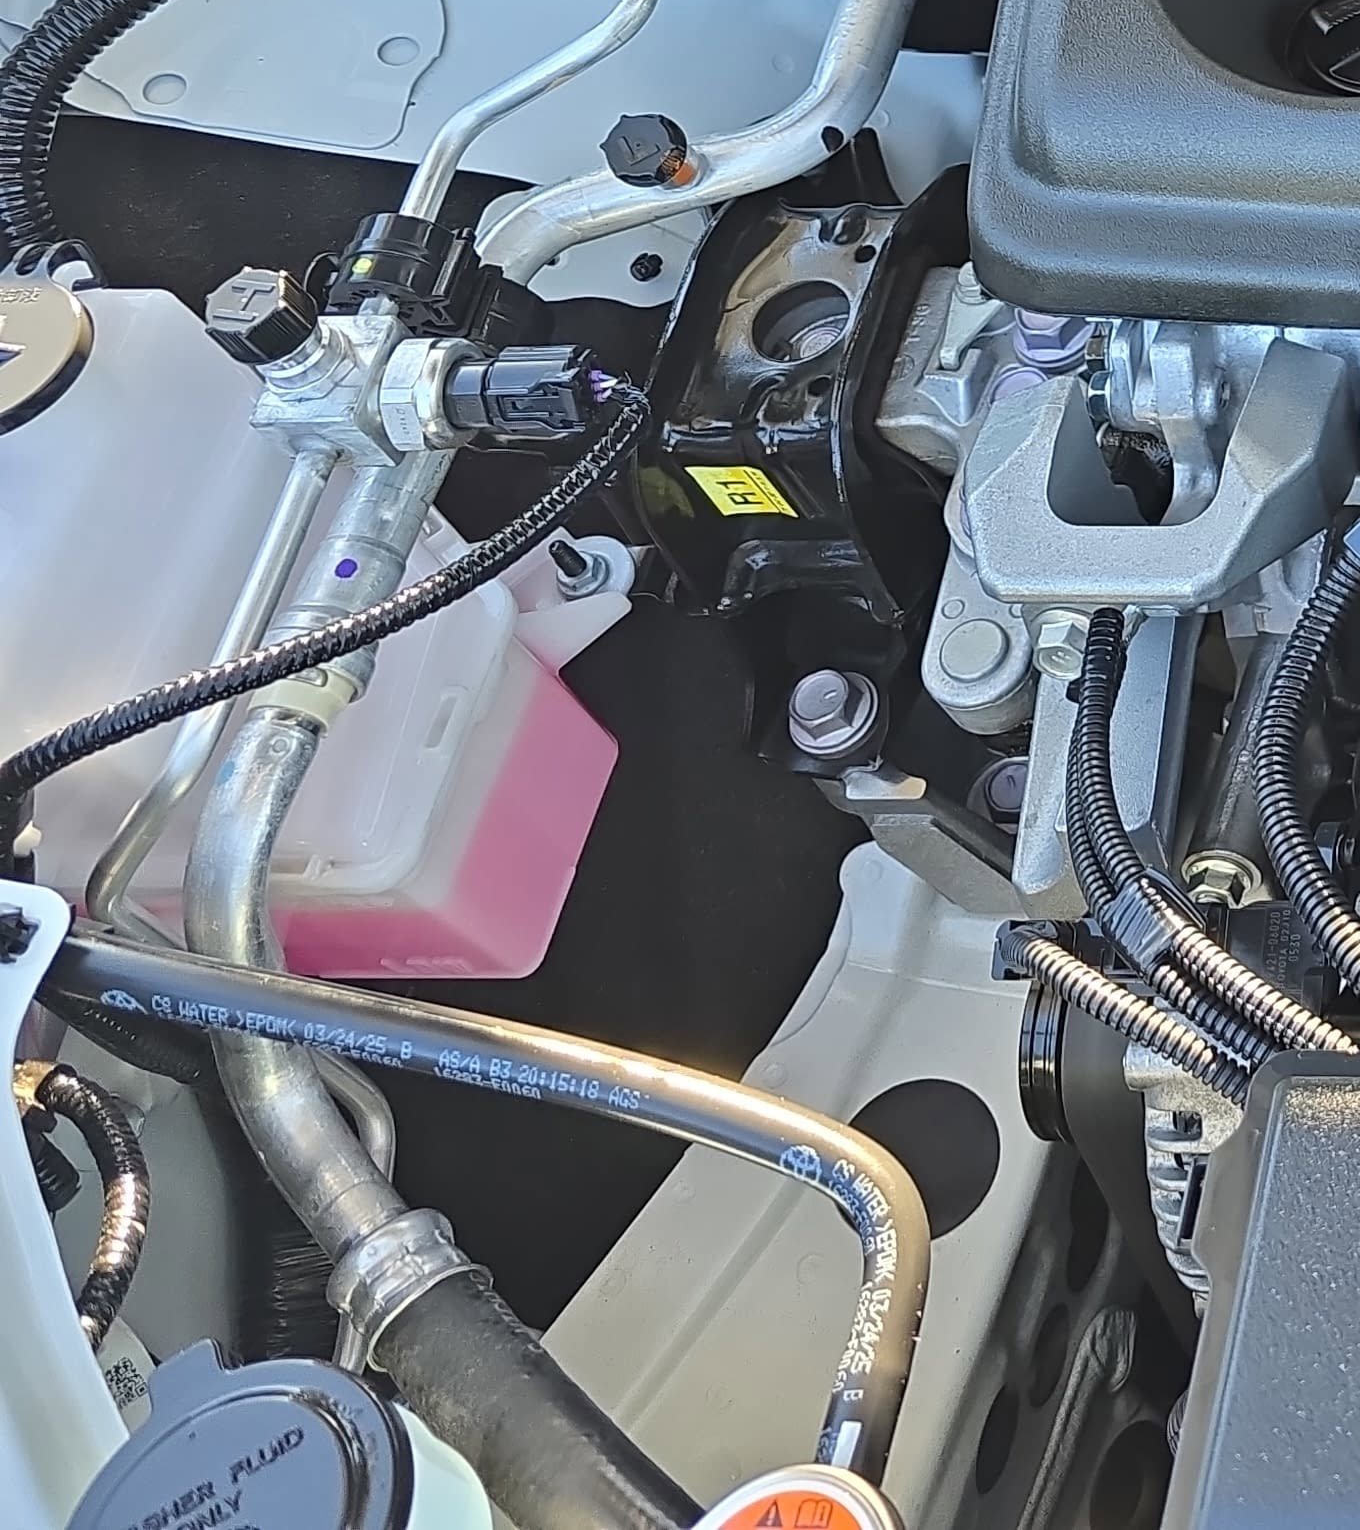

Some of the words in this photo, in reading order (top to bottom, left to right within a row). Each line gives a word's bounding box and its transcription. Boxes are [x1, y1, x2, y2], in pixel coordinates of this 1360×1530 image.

[715, 480, 765, 505] R1
[178, 1000, 228, 1024] WATER
[303, 1022, 389, 1054] 03/24/25
[517, 1064, 601, 1100] 20:15:18
[851, 1173, 892, 1222] WATER
[226, 1426, 305, 1486] FLUID
